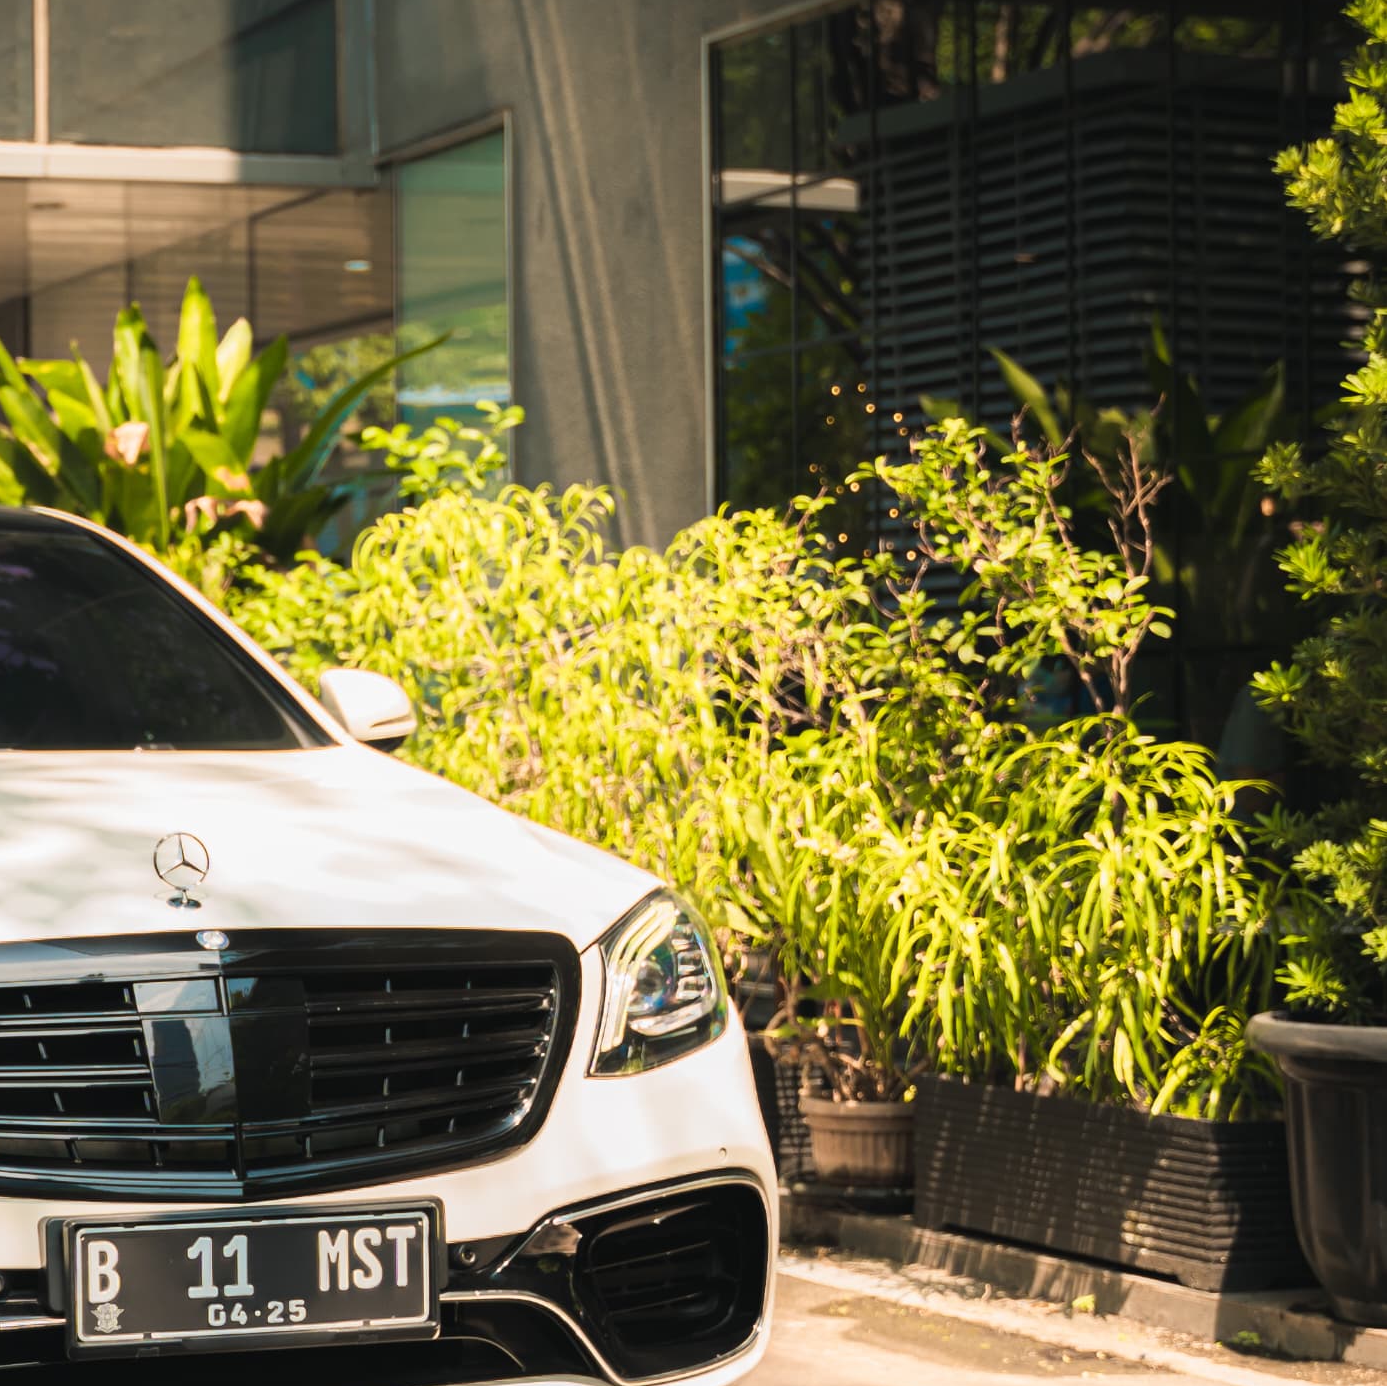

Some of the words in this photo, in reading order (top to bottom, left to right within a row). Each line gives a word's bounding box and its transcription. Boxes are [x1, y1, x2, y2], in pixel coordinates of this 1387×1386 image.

[87, 1239, 121, 1304] B
[187, 1234, 255, 1299] 11
[317, 1224, 417, 1292] MST
